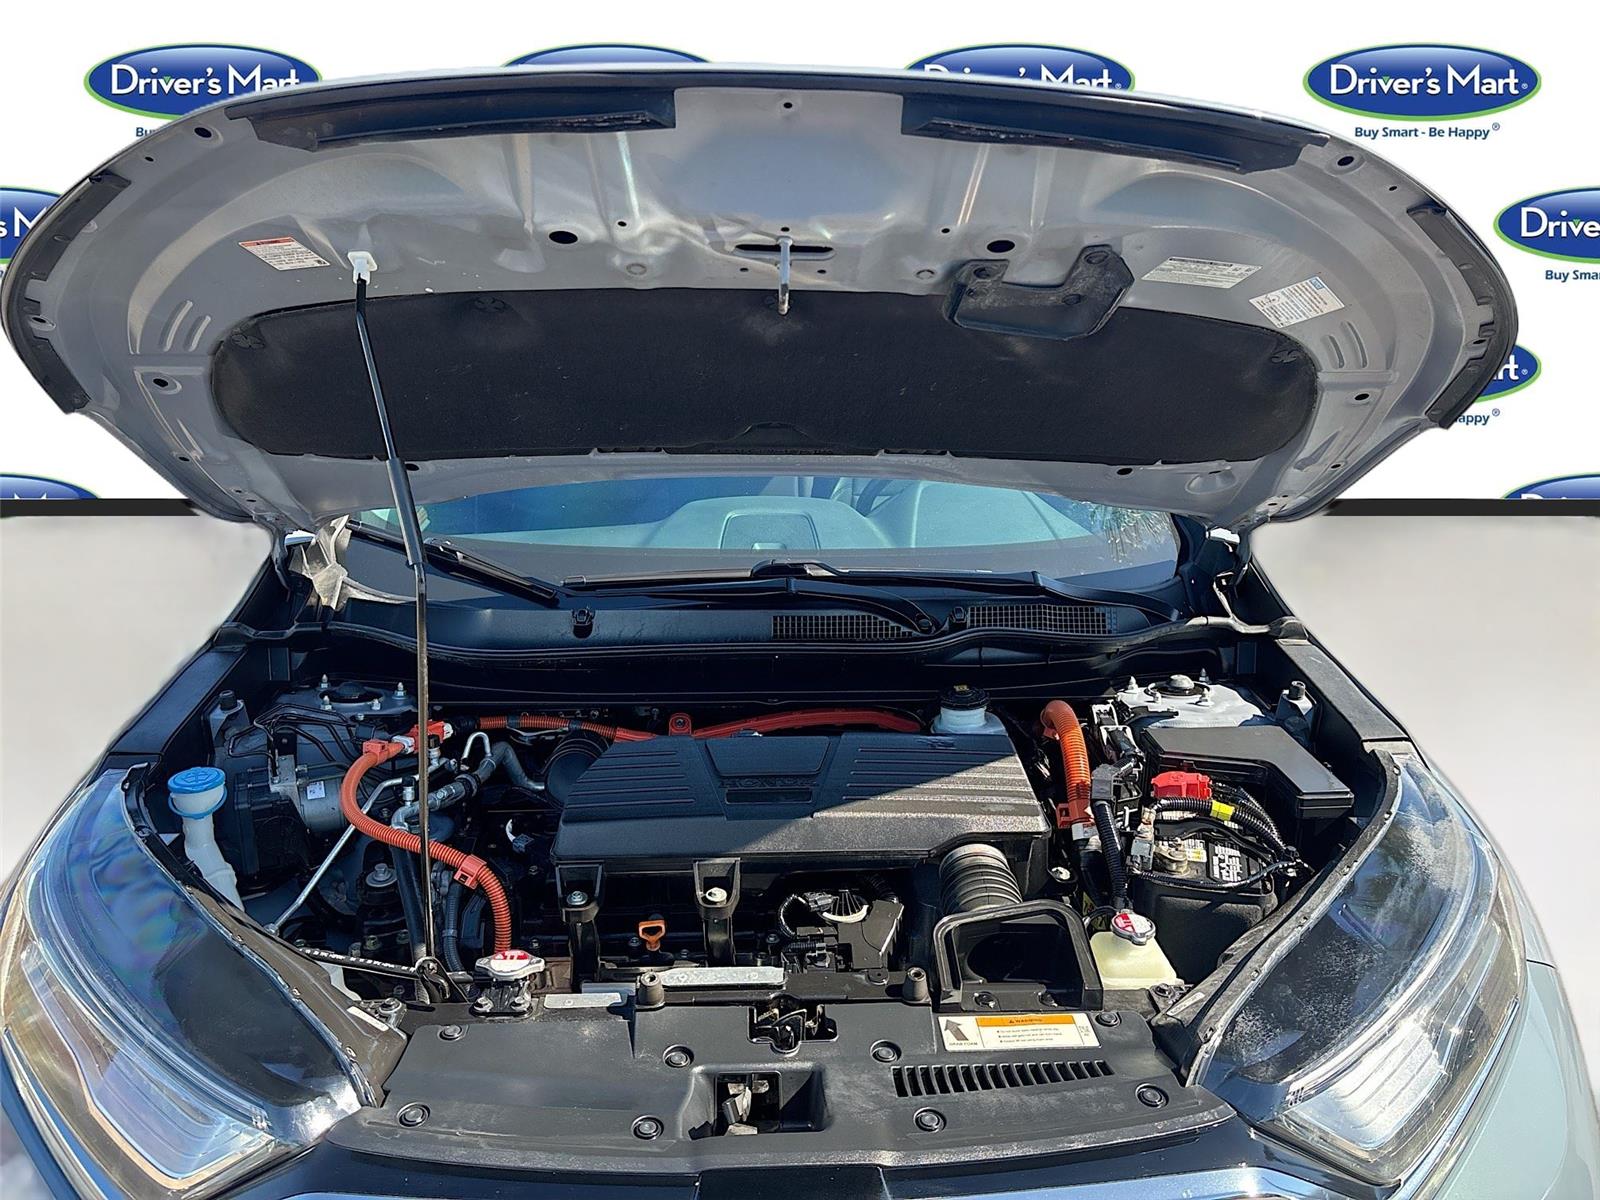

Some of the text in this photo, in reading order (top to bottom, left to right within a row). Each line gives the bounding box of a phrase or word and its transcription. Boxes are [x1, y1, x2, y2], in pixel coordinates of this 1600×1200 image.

[111, 64, 222, 95] Driver's
[1330, 64, 1519, 95] Driver's Mart
[1355, 128, 1379, 139] Buy
[1382, 127, 1418, 138] Smart
[1429, 128, 1445, 137] Be
[1449, 128, 1490, 140] Happy
[1521, 207, 1600, 238] Drive
[1545, 270, 1569, 282] Buy
[1456, 414, 1490, 425] appy
